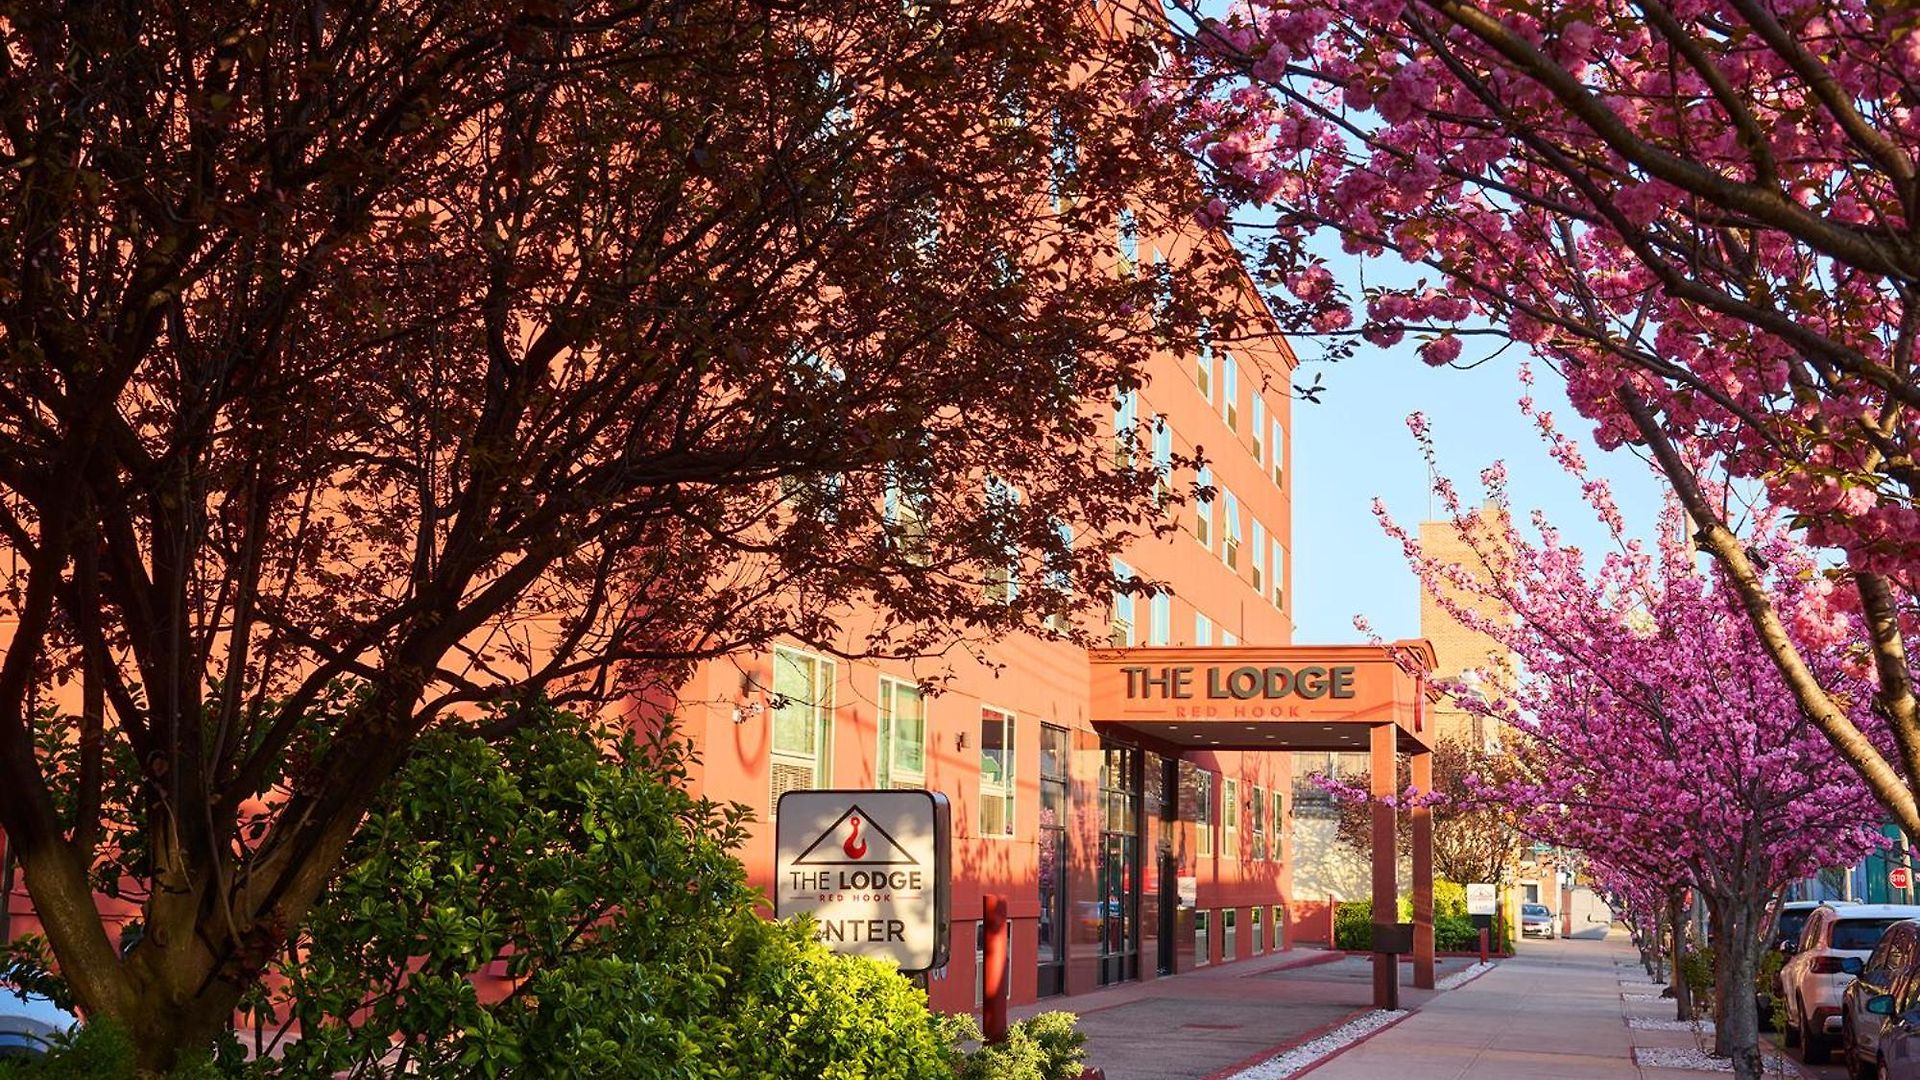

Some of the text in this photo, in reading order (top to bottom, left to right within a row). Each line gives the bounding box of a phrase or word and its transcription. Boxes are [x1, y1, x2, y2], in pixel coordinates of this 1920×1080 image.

[1120, 666, 1355, 700] THE LODGE
[1176, 706, 1301, 718] RED HOOK
[789, 871, 921, 890] THE LODGE
[820, 894, 891, 902] RED HOOK
